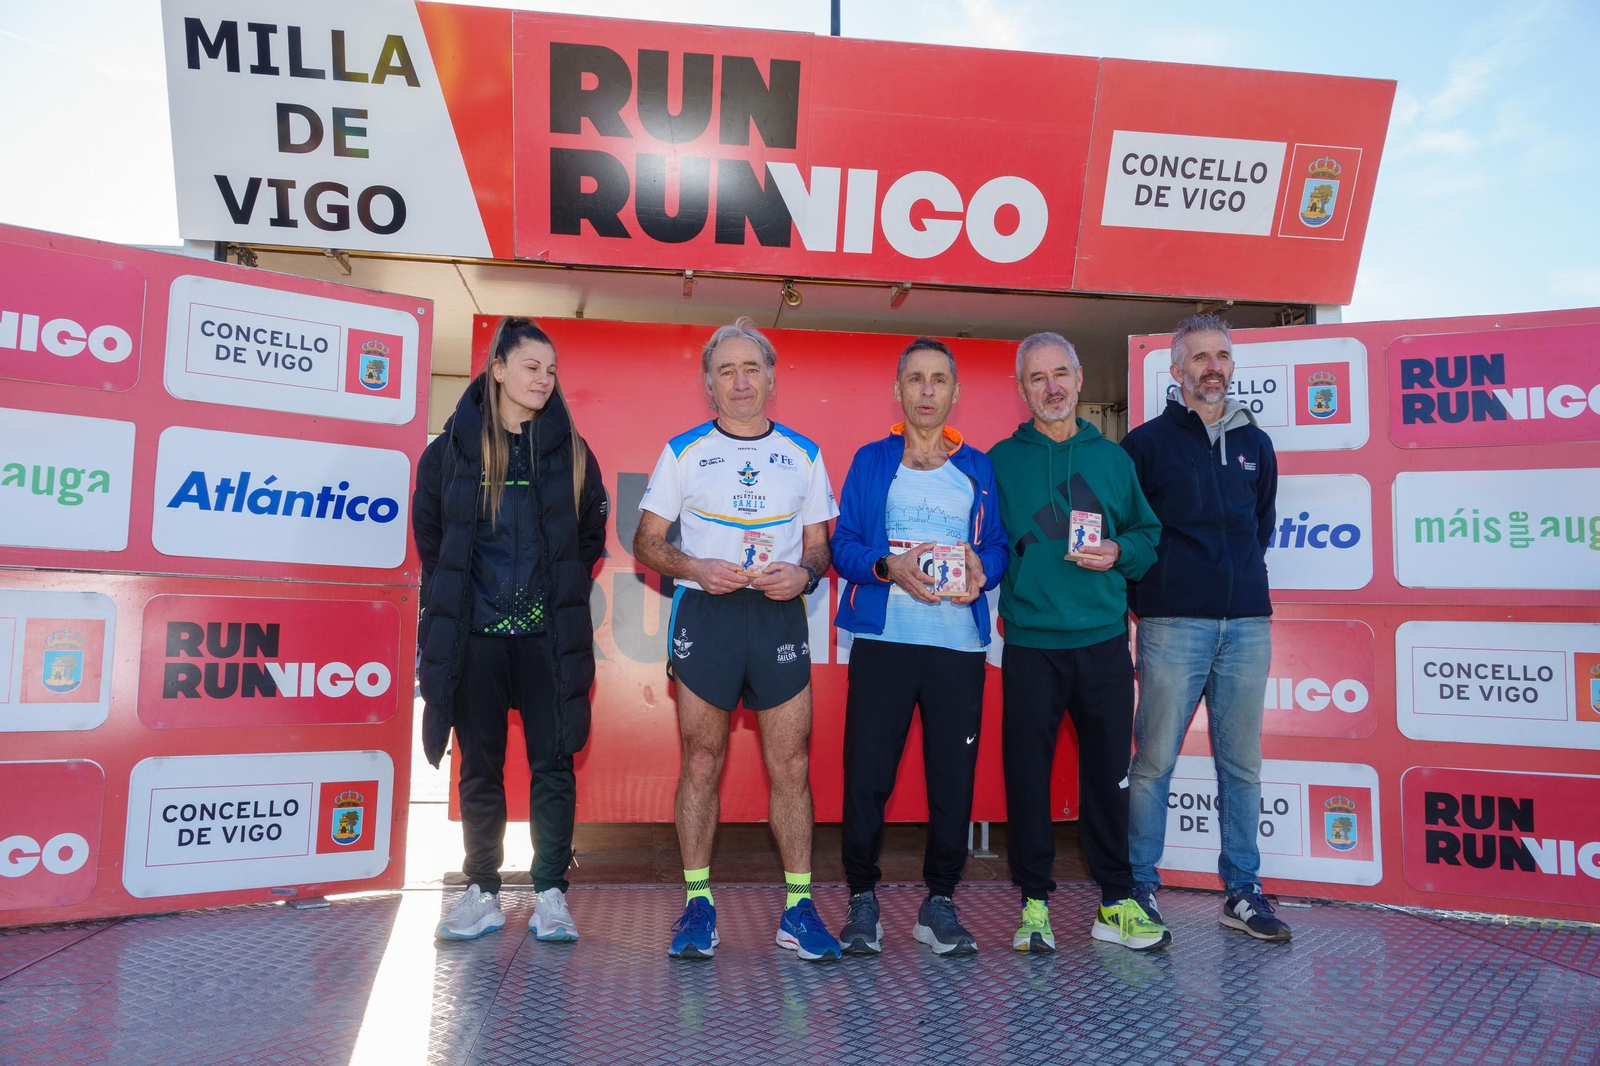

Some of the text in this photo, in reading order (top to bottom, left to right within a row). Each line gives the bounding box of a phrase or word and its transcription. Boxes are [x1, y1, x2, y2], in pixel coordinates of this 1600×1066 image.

[184, 17, 421, 87] MILLA
[550, 41, 801, 149] RUN
[276, 102, 369, 159] DE
[1122, 152, 1268, 184] CONCELLO
[214, 174, 407, 235] VIGO
[1134, 184, 1246, 213] DE VIGO
[200, 320, 329, 354] CONCELLO
[215, 344, 314, 373] DE VIGO
[1400, 353, 1506, 390] RUN
[1, 462, 111, 506] auga
[166, 470, 400, 524] Atlántico
[945, 528, 962, 540] 2025
[1414, 507, 1502, 544] máis
[1508, 510, 1536, 550] que
[165, 621, 281, 659] RUN
[776, 651, 798, 662] SAILOR
[1422, 661, 1555, 683] CONCELLO
[1439, 683, 1540, 704] DE VIGO
[161, 798, 300, 824] CONCELLO
[1180, 814, 1210, 834] DE
[1424, 791, 1535, 834] RUN
[177, 823, 283, 847] DE VIGO
